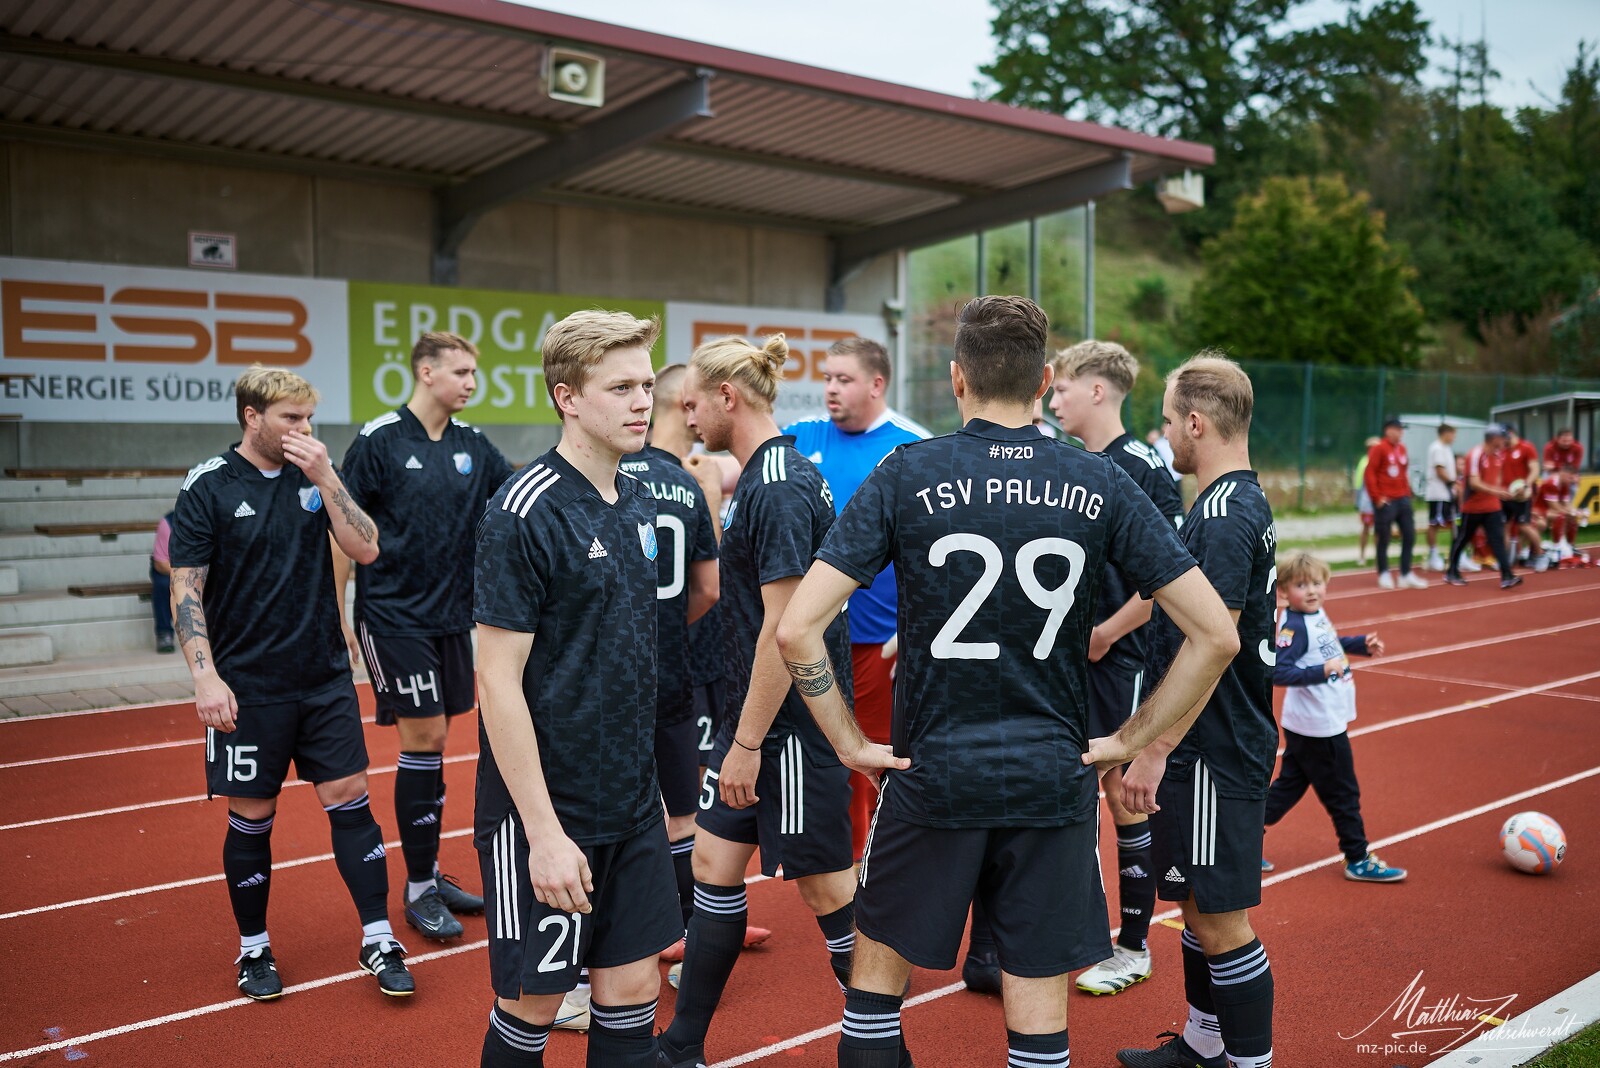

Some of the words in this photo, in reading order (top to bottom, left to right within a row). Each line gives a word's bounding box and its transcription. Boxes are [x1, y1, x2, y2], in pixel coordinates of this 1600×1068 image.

[2, 279, 312, 367] ESB
[4, 374, 135, 401] ENERGIE
[989, 444, 1034, 460] #1920
[642, 481, 695, 509] LLING
[916, 478, 972, 515] TSV
[986, 478, 1104, 520] PALLING
[587, 549, 608, 559] adidas
[928, 532, 1086, 661] 29
[395, 670, 438, 708] 44
[225, 744, 259, 782] 15
[1164, 874, 1186, 883] adidas
[537, 912, 582, 974] 21
